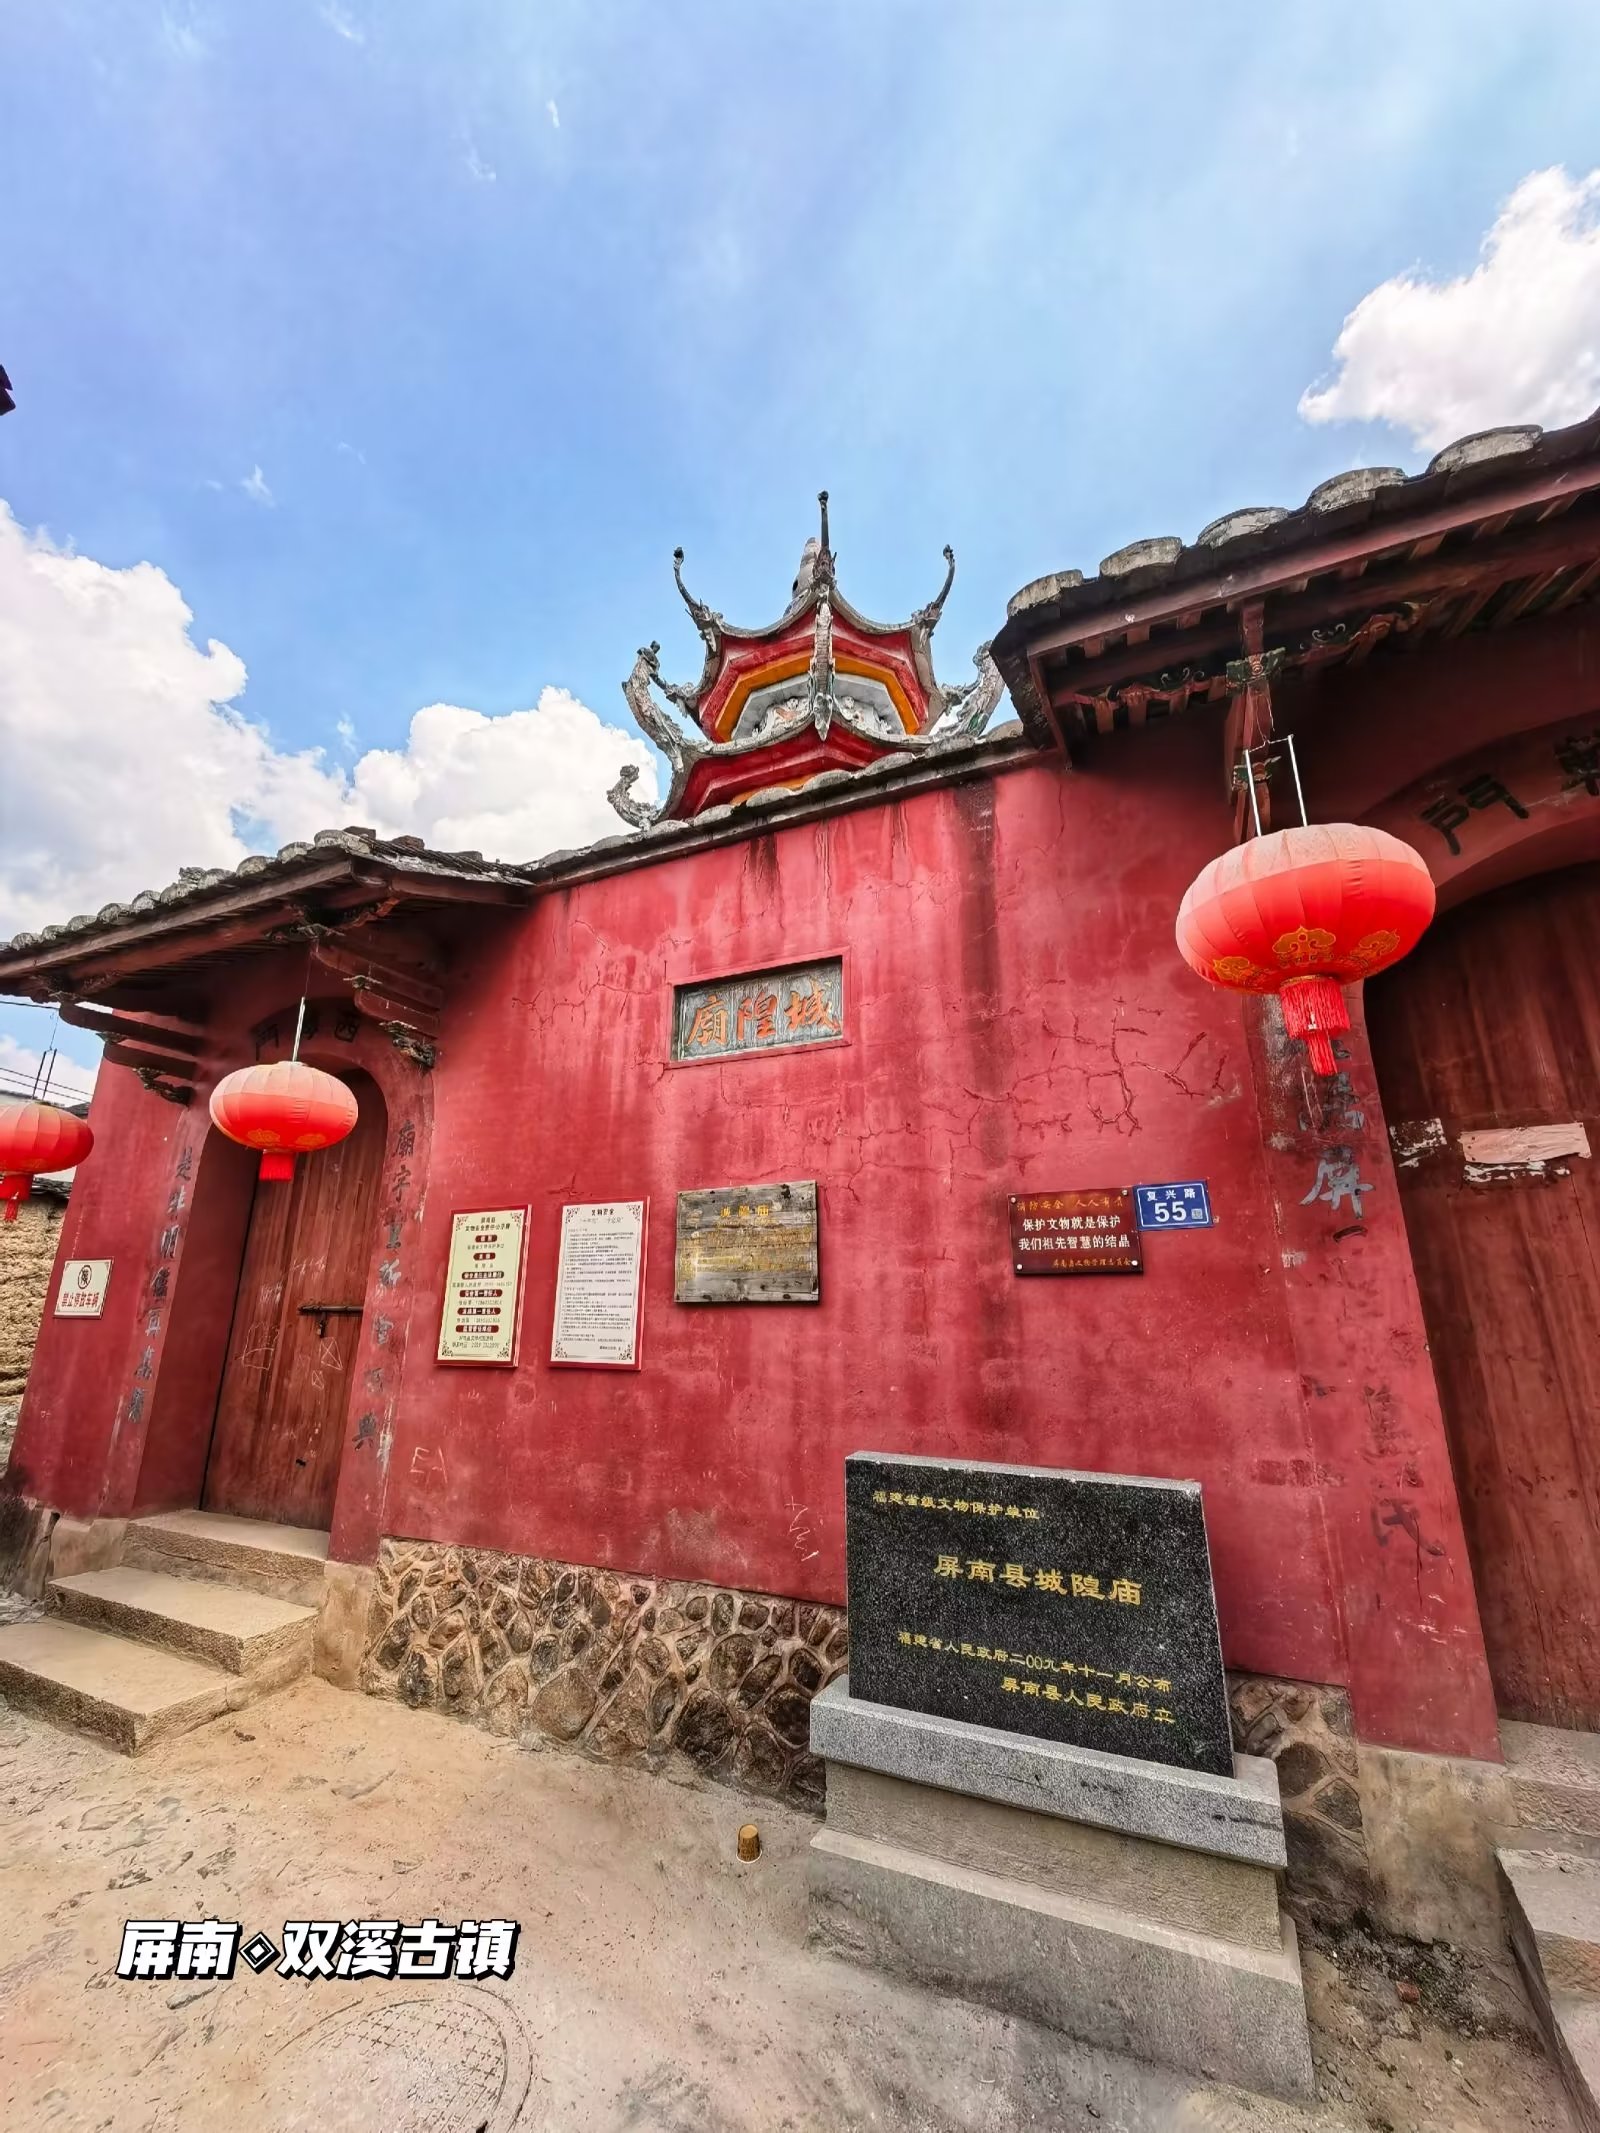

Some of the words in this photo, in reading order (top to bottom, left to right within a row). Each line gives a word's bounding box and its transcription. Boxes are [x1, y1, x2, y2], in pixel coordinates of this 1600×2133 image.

[1146, 1187, 1197, 1202] 复兴路
[1016, 1199, 1065, 1212] 消防安全
[1154, 1201, 1187, 1223] 55
[1022, 1214, 1121, 1232] 保护文物就是保护
[1018, 1234, 1131, 1251] 我们祖先智慧的结晶
[872, 1489, 1040, 1520] 福建省级文物保护单位
[932, 1553, 1143, 1607] 屏南县城隍庙
[1001, 1675, 1177, 1725] 屏南县人民政府立
